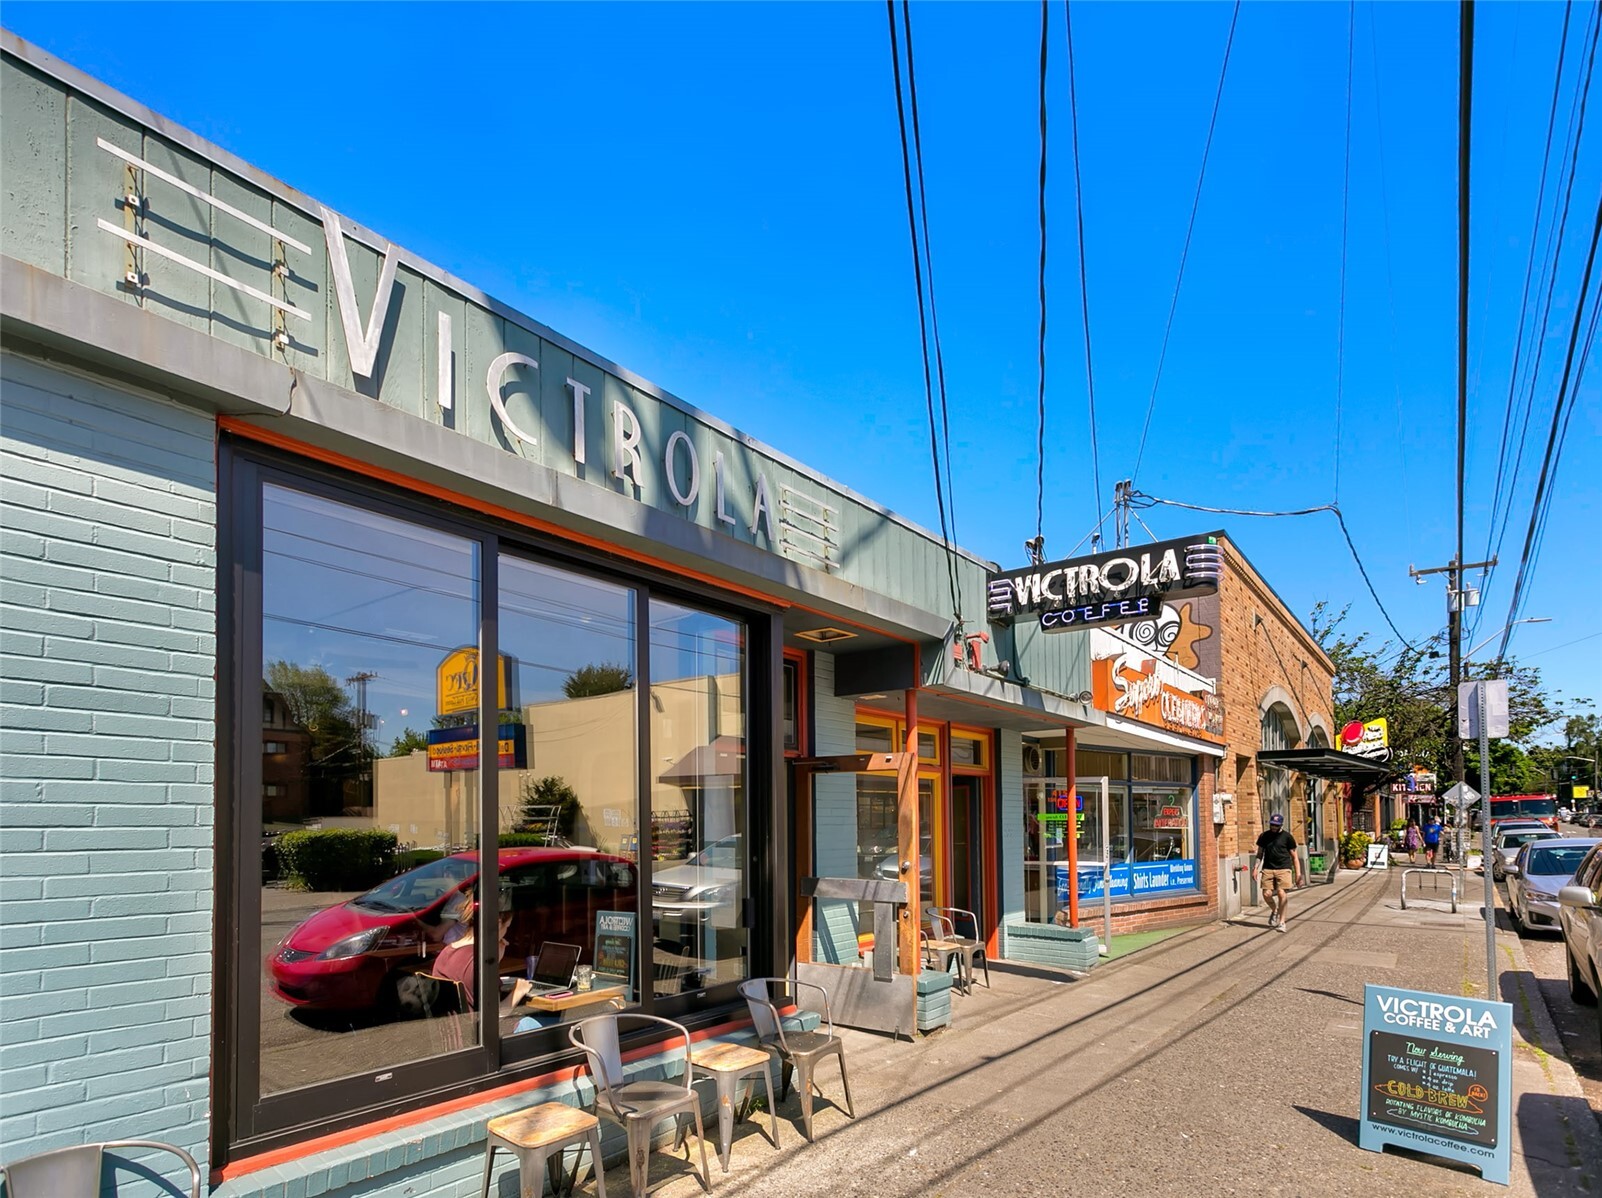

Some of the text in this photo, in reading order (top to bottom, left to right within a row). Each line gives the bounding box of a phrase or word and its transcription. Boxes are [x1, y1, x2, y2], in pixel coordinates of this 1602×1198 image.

[320, 206, 776, 543] VICTROLA
[1014, 548, 1181, 606] VICTROLA
[1042, 597, 1149, 627] COFFEE
[1133, 873, 1149, 889] Shirts
[1376, 994, 1498, 1029] VICTROLA
[1383, 1012, 1491, 1039] COFFEE & ART
[1387, 1054, 1477, 1080] TRY A FLIGHT OF GUATEMALA!
[1393, 1063, 1410, 1072] COMES
[1406, 1041, 1465, 1066] Now Serving
[1433, 1071, 1458, 1080] espresso
[1387, 1079, 1469, 1109] COLD BREW
[1385, 1098, 1414, 1110] ROTATING
[1416, 1104, 1442, 1116] FLAVORS
[1454, 1112, 1486, 1127] KOMBUCHA
[1397, 1107, 1468, 1131] BY MYSTIC KOMBUCHA
[1372, 1124, 1495, 1158] www.victrolacoffee.com
